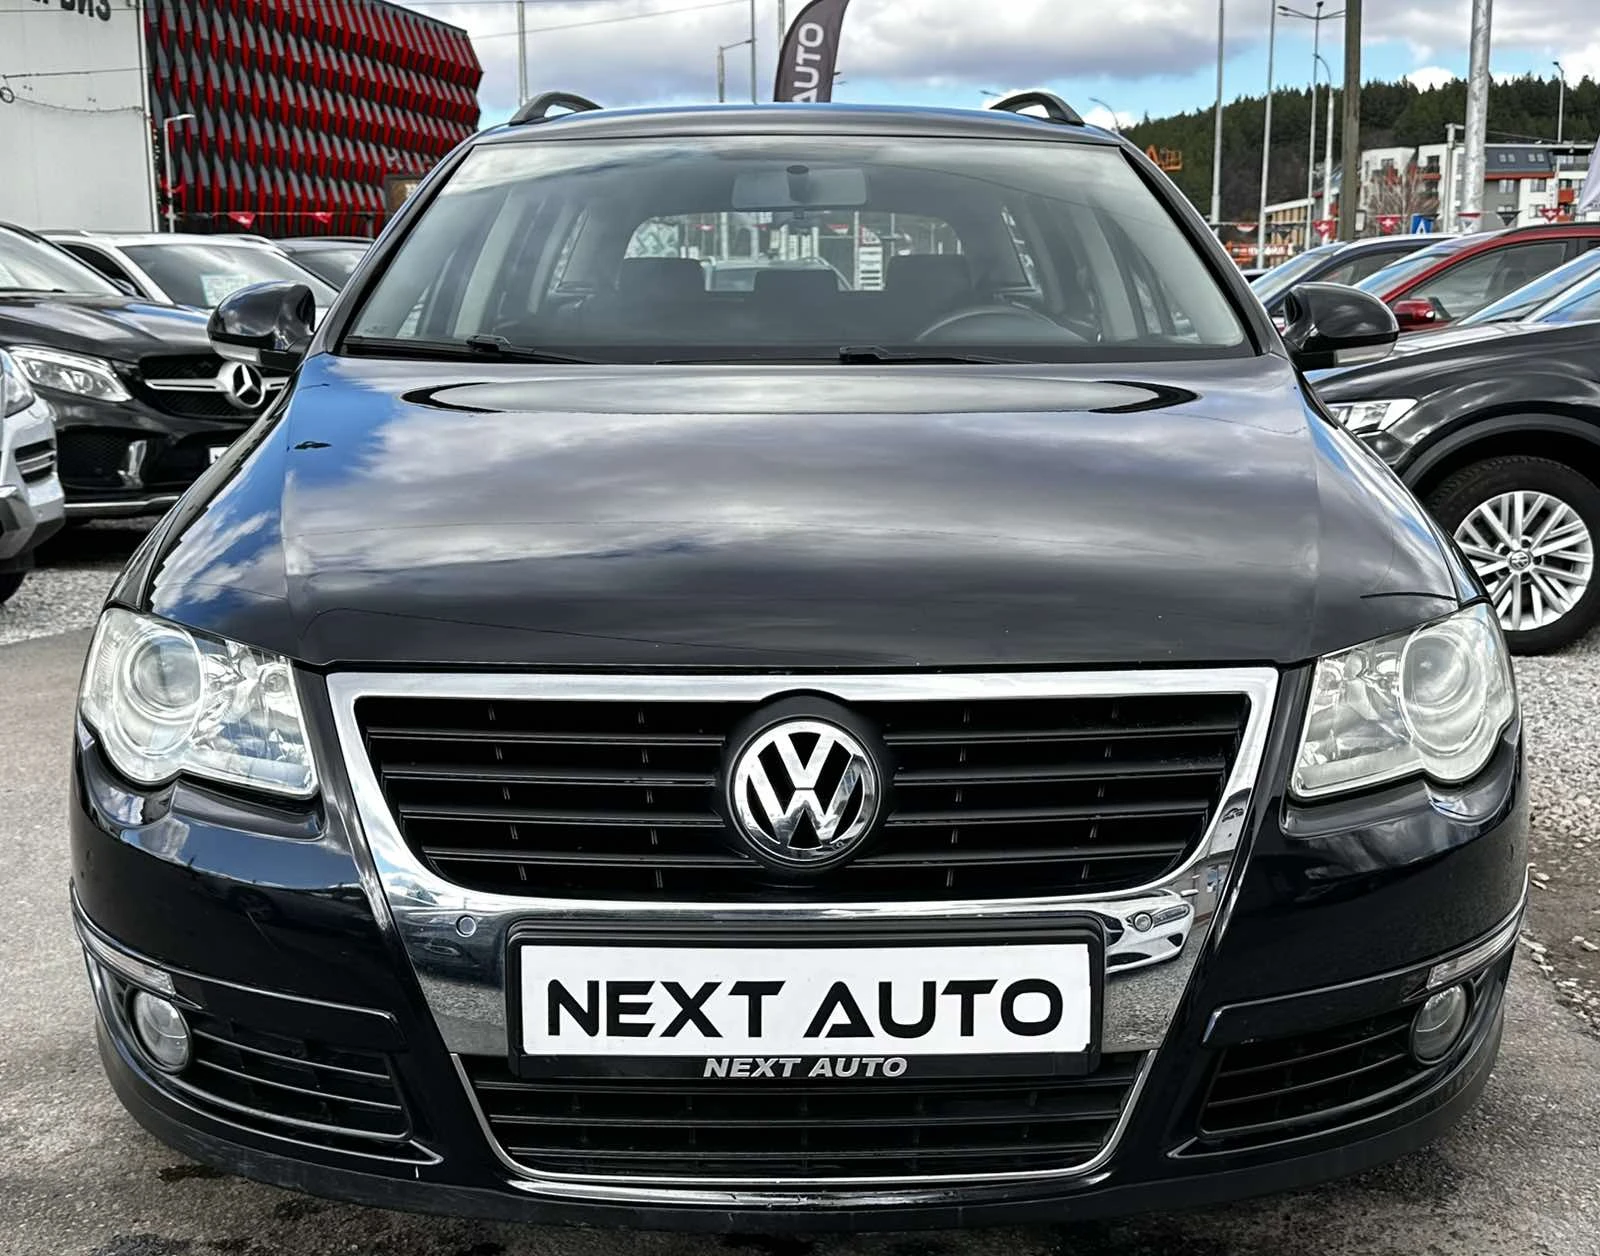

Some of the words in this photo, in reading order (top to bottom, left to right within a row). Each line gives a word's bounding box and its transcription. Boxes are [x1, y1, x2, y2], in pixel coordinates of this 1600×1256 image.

[735, 721, 875, 861] VW
[547, 980, 786, 1038] NEXT
[802, 979, 1064, 1038] AUTO
[703, 1058, 802, 1077] NEXT
[808, 1057, 908, 1077] AUTO
